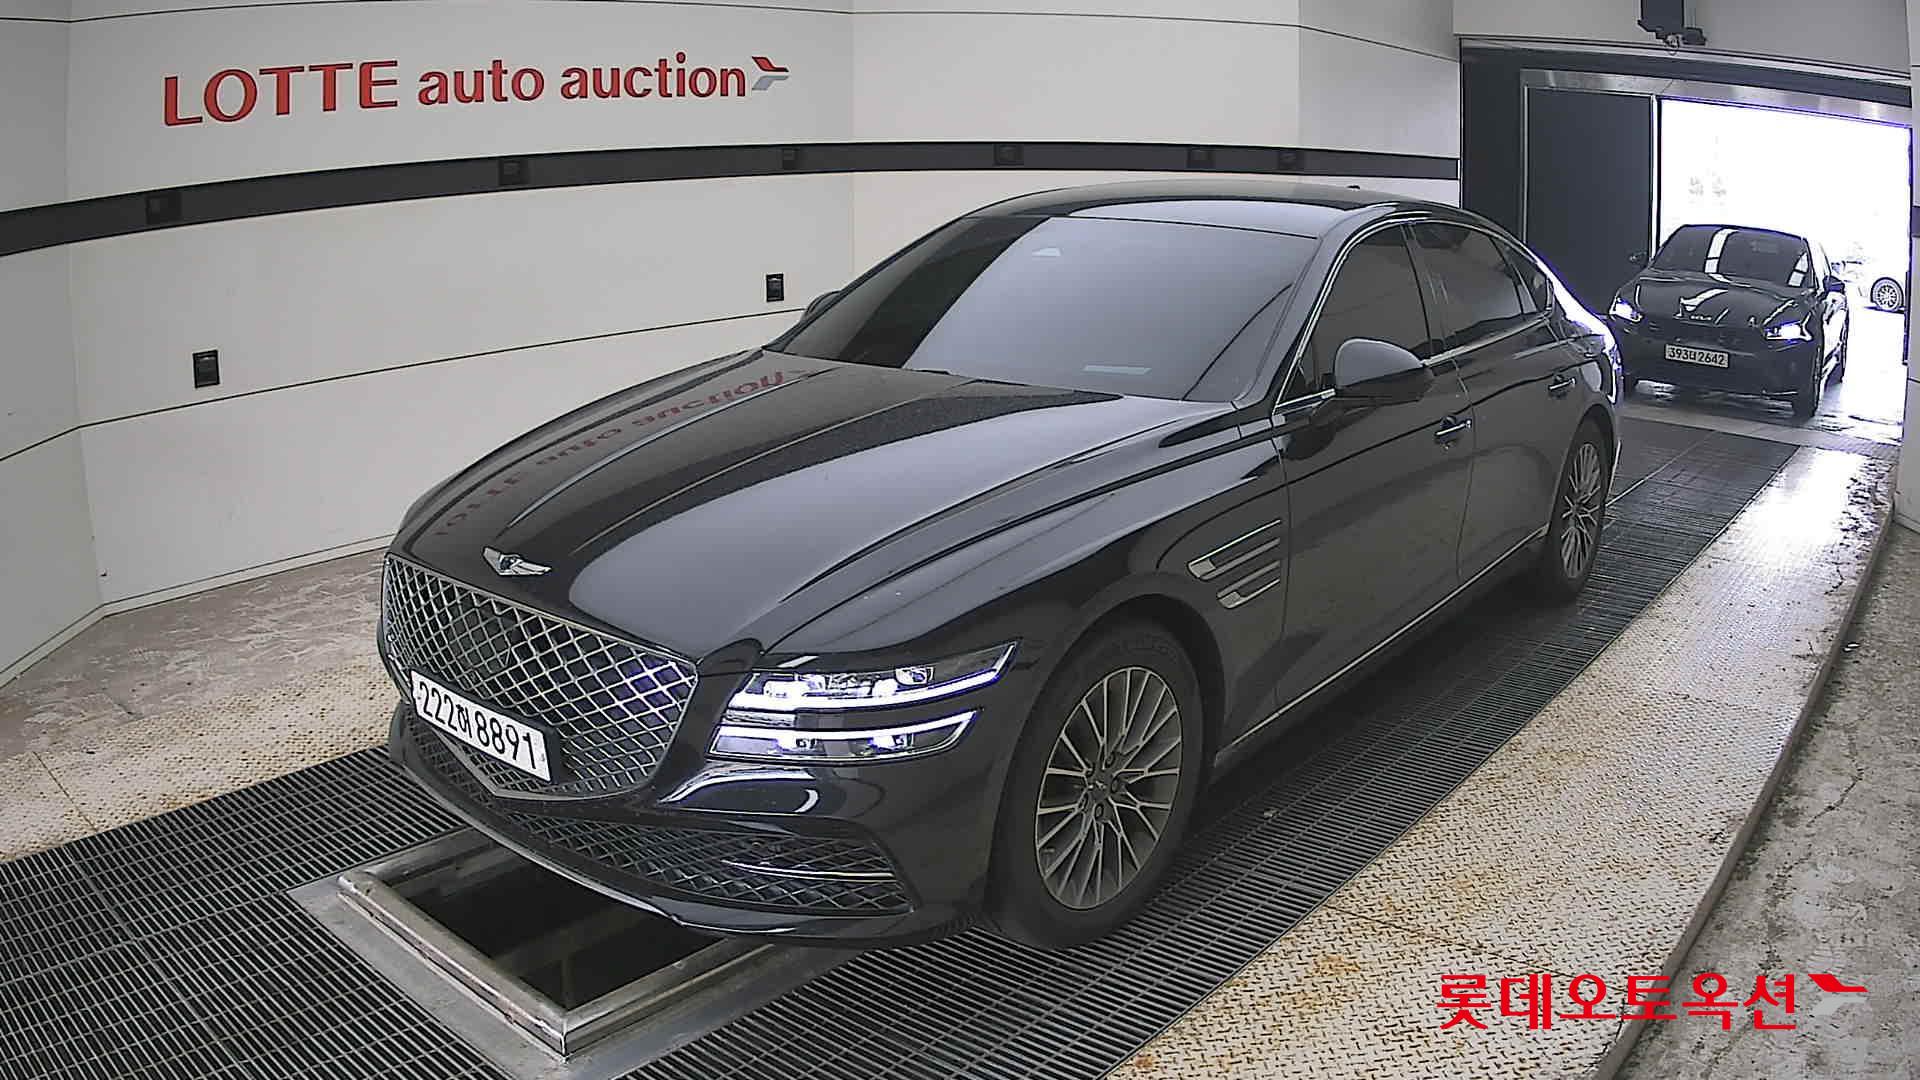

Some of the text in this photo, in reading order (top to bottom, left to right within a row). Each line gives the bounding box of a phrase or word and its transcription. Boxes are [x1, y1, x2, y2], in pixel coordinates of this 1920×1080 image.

[163, 51, 747, 126] LOTTE auto auction
[419, 681, 537, 770] 222허8891
